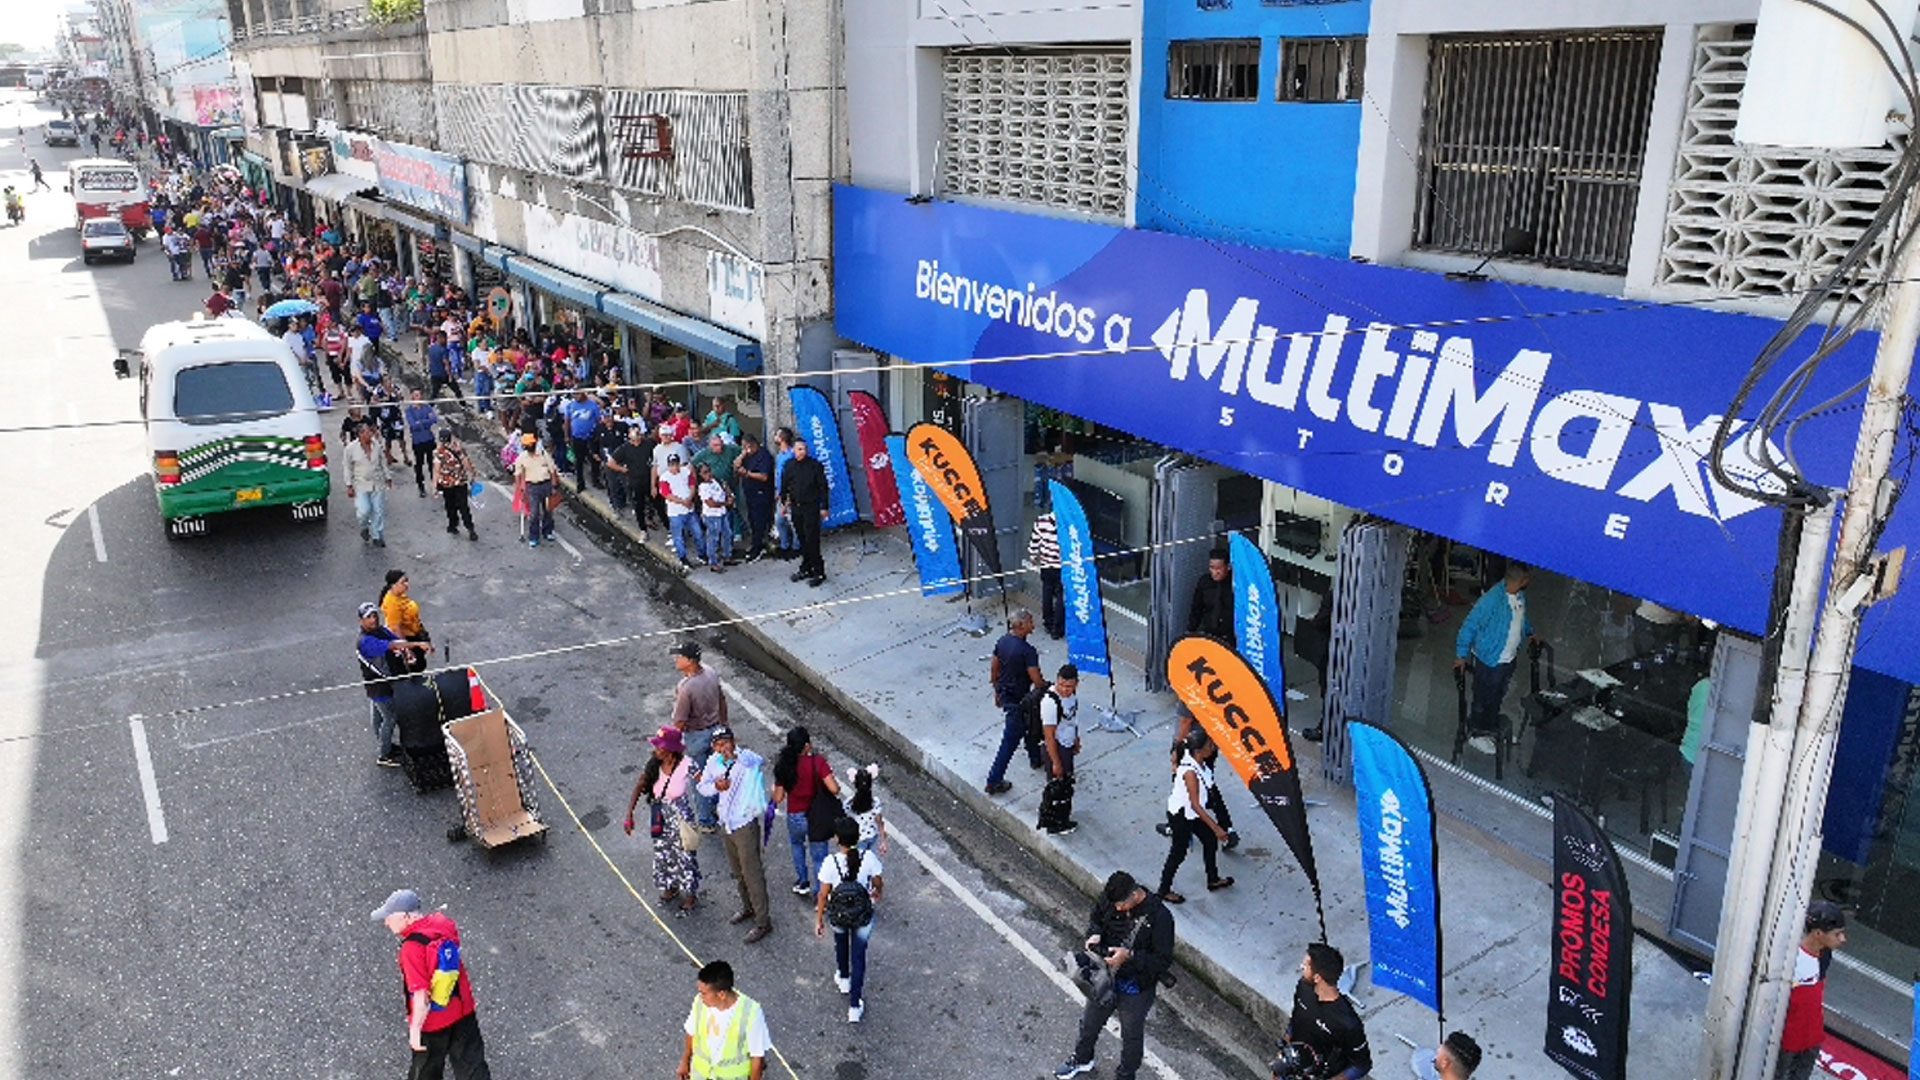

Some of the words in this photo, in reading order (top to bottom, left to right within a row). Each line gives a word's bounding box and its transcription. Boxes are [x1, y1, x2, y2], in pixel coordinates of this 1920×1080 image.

[916, 259, 1096, 344] Bienvenidos
[1104, 313, 1132, 353] a
[1169, 288, 1750, 520] MultiMax
[1186, 656, 1283, 774] KUCCE
[1559, 872, 1586, 985] PROMOS
[1588, 889, 1611, 999] CONDESA
